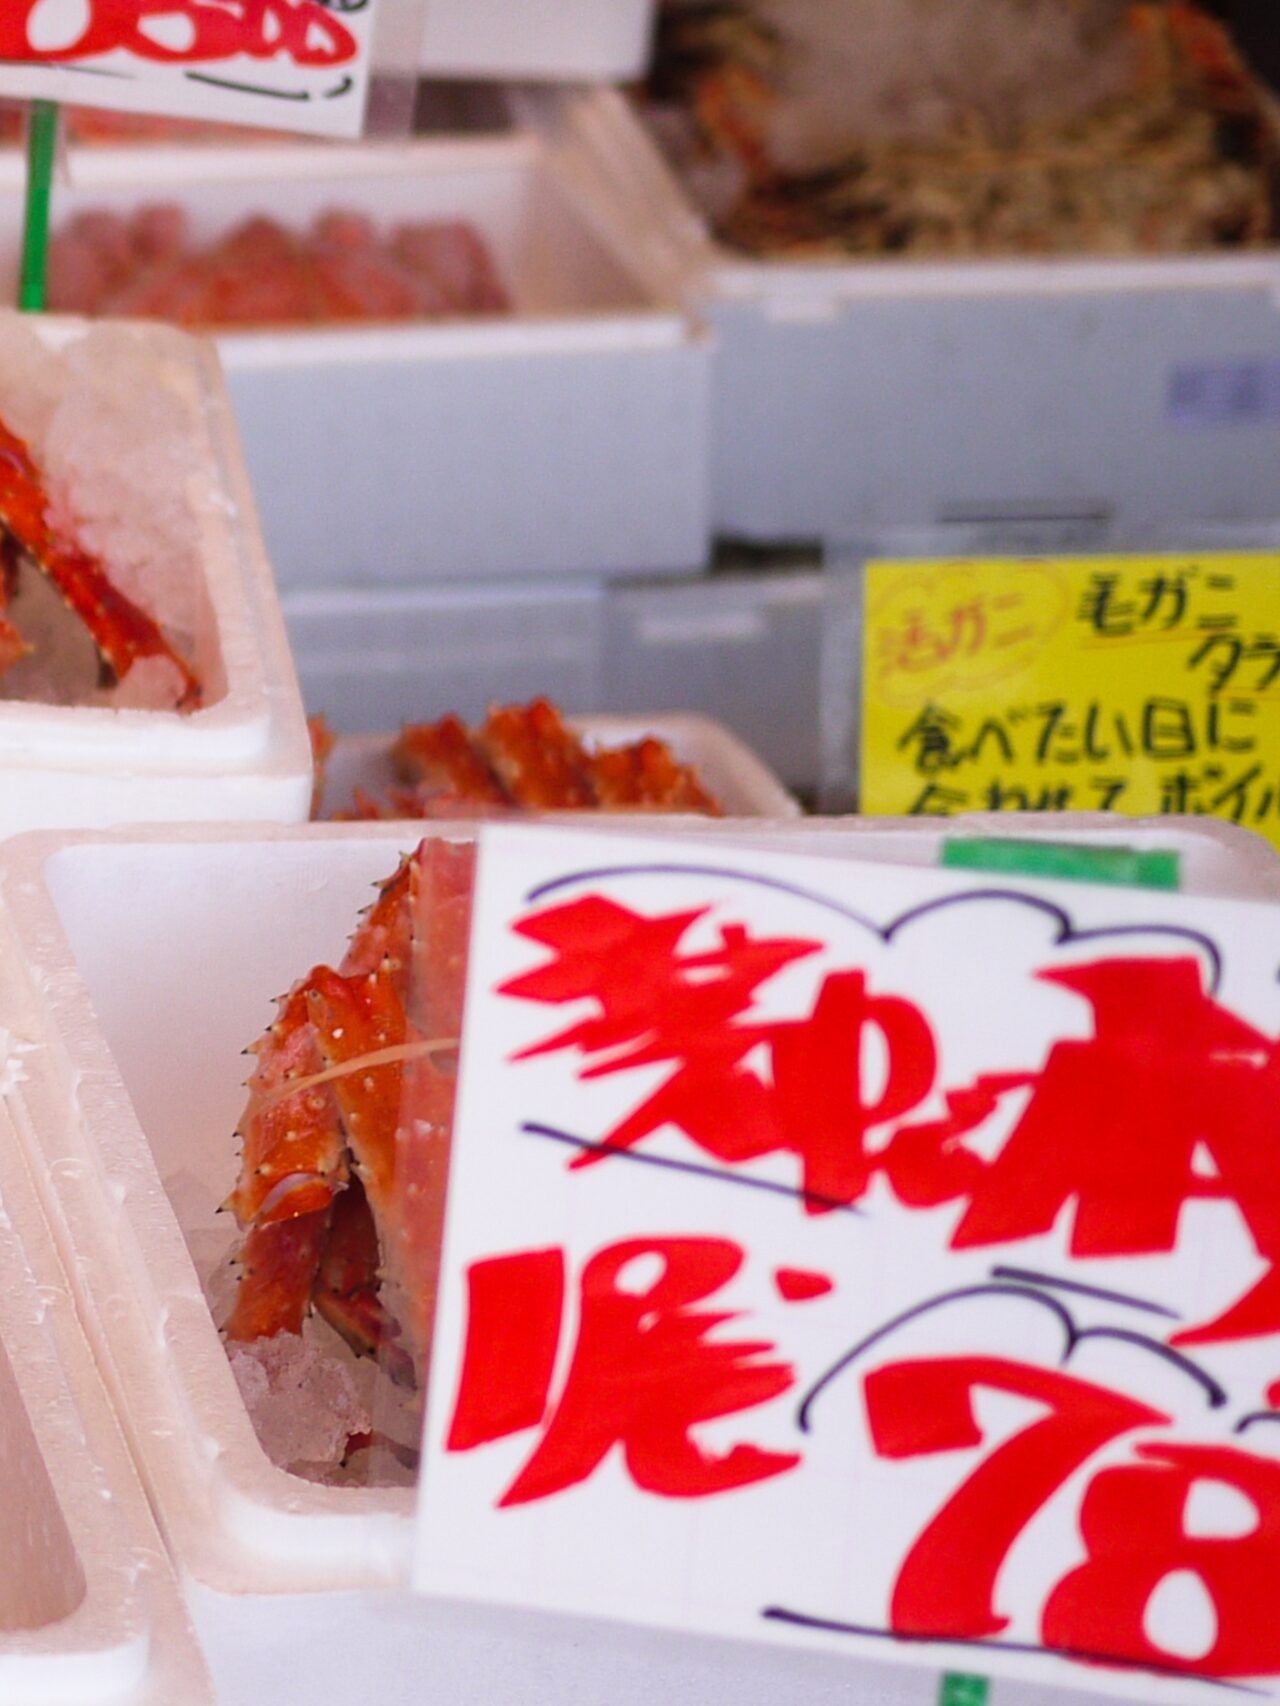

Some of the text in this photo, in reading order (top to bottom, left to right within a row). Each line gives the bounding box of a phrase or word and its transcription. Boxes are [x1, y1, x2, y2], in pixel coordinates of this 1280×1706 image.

[896, 700, 1257, 775] 食べたい日に
